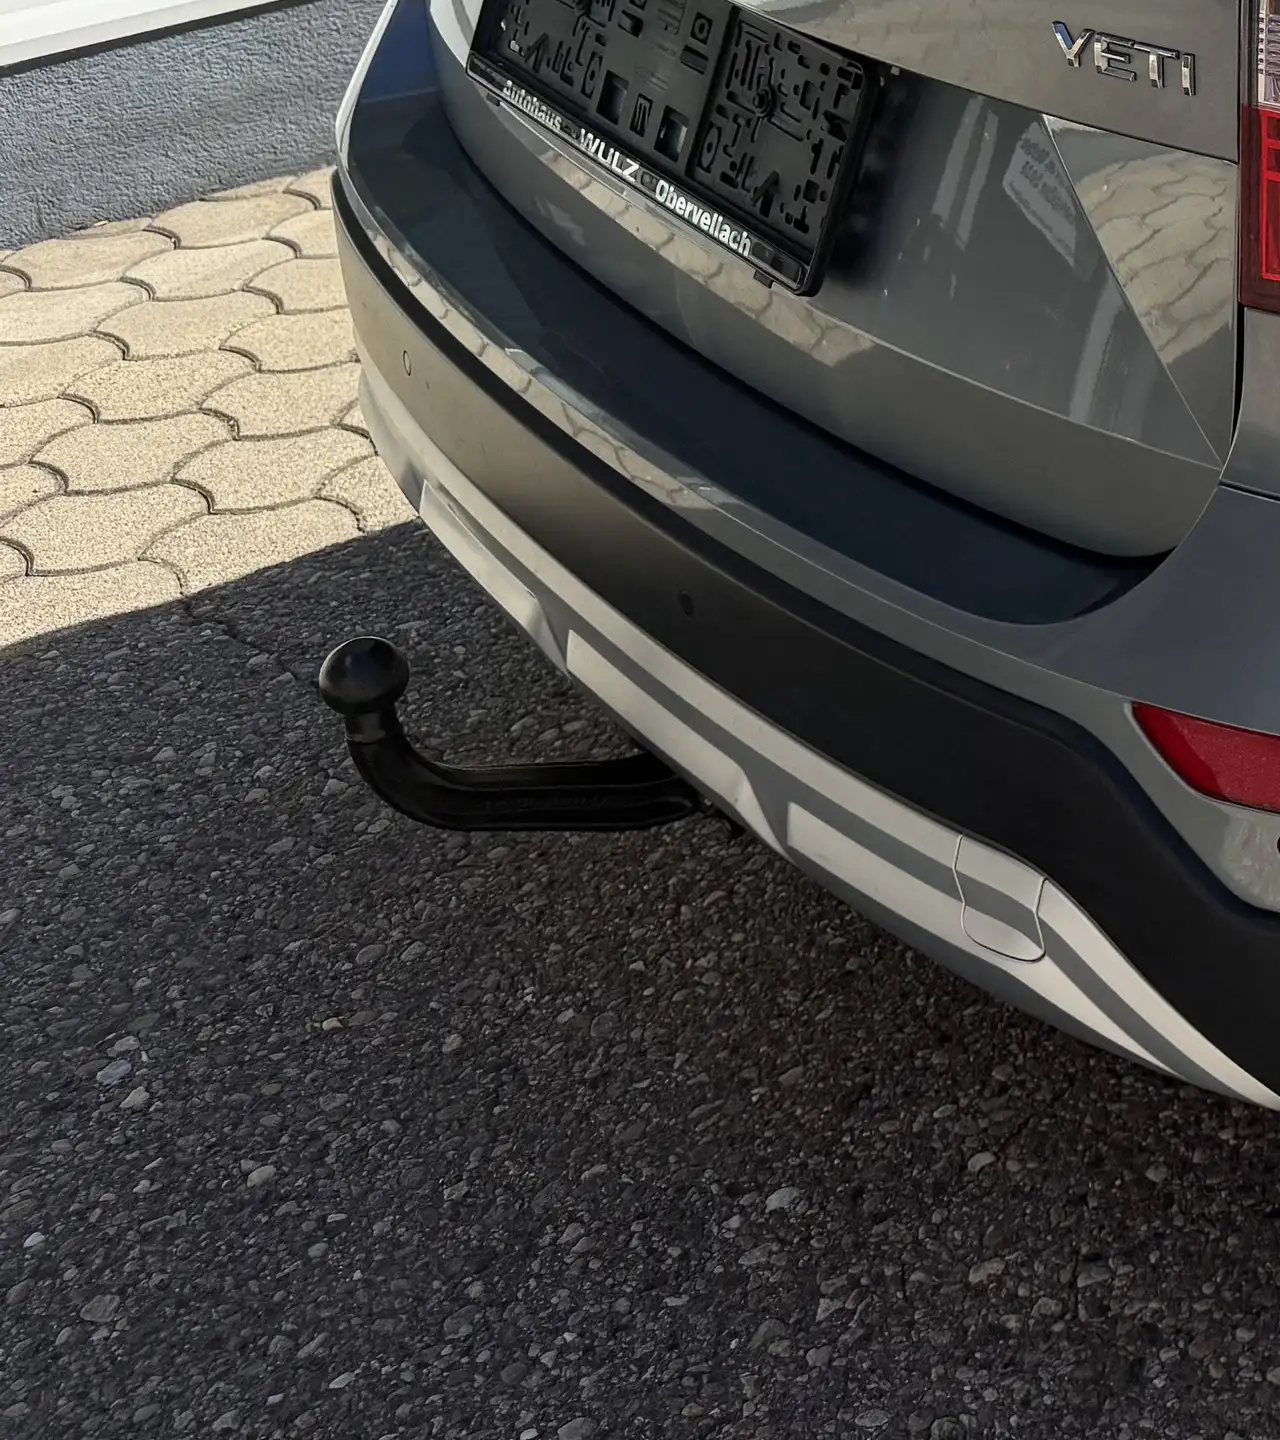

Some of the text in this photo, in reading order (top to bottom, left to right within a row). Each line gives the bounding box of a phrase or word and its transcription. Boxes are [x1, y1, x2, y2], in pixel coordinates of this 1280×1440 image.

[1052, 20, 1196, 96] YETI
[502, 80, 752, 257] Autohaus WULZ Obervellach
